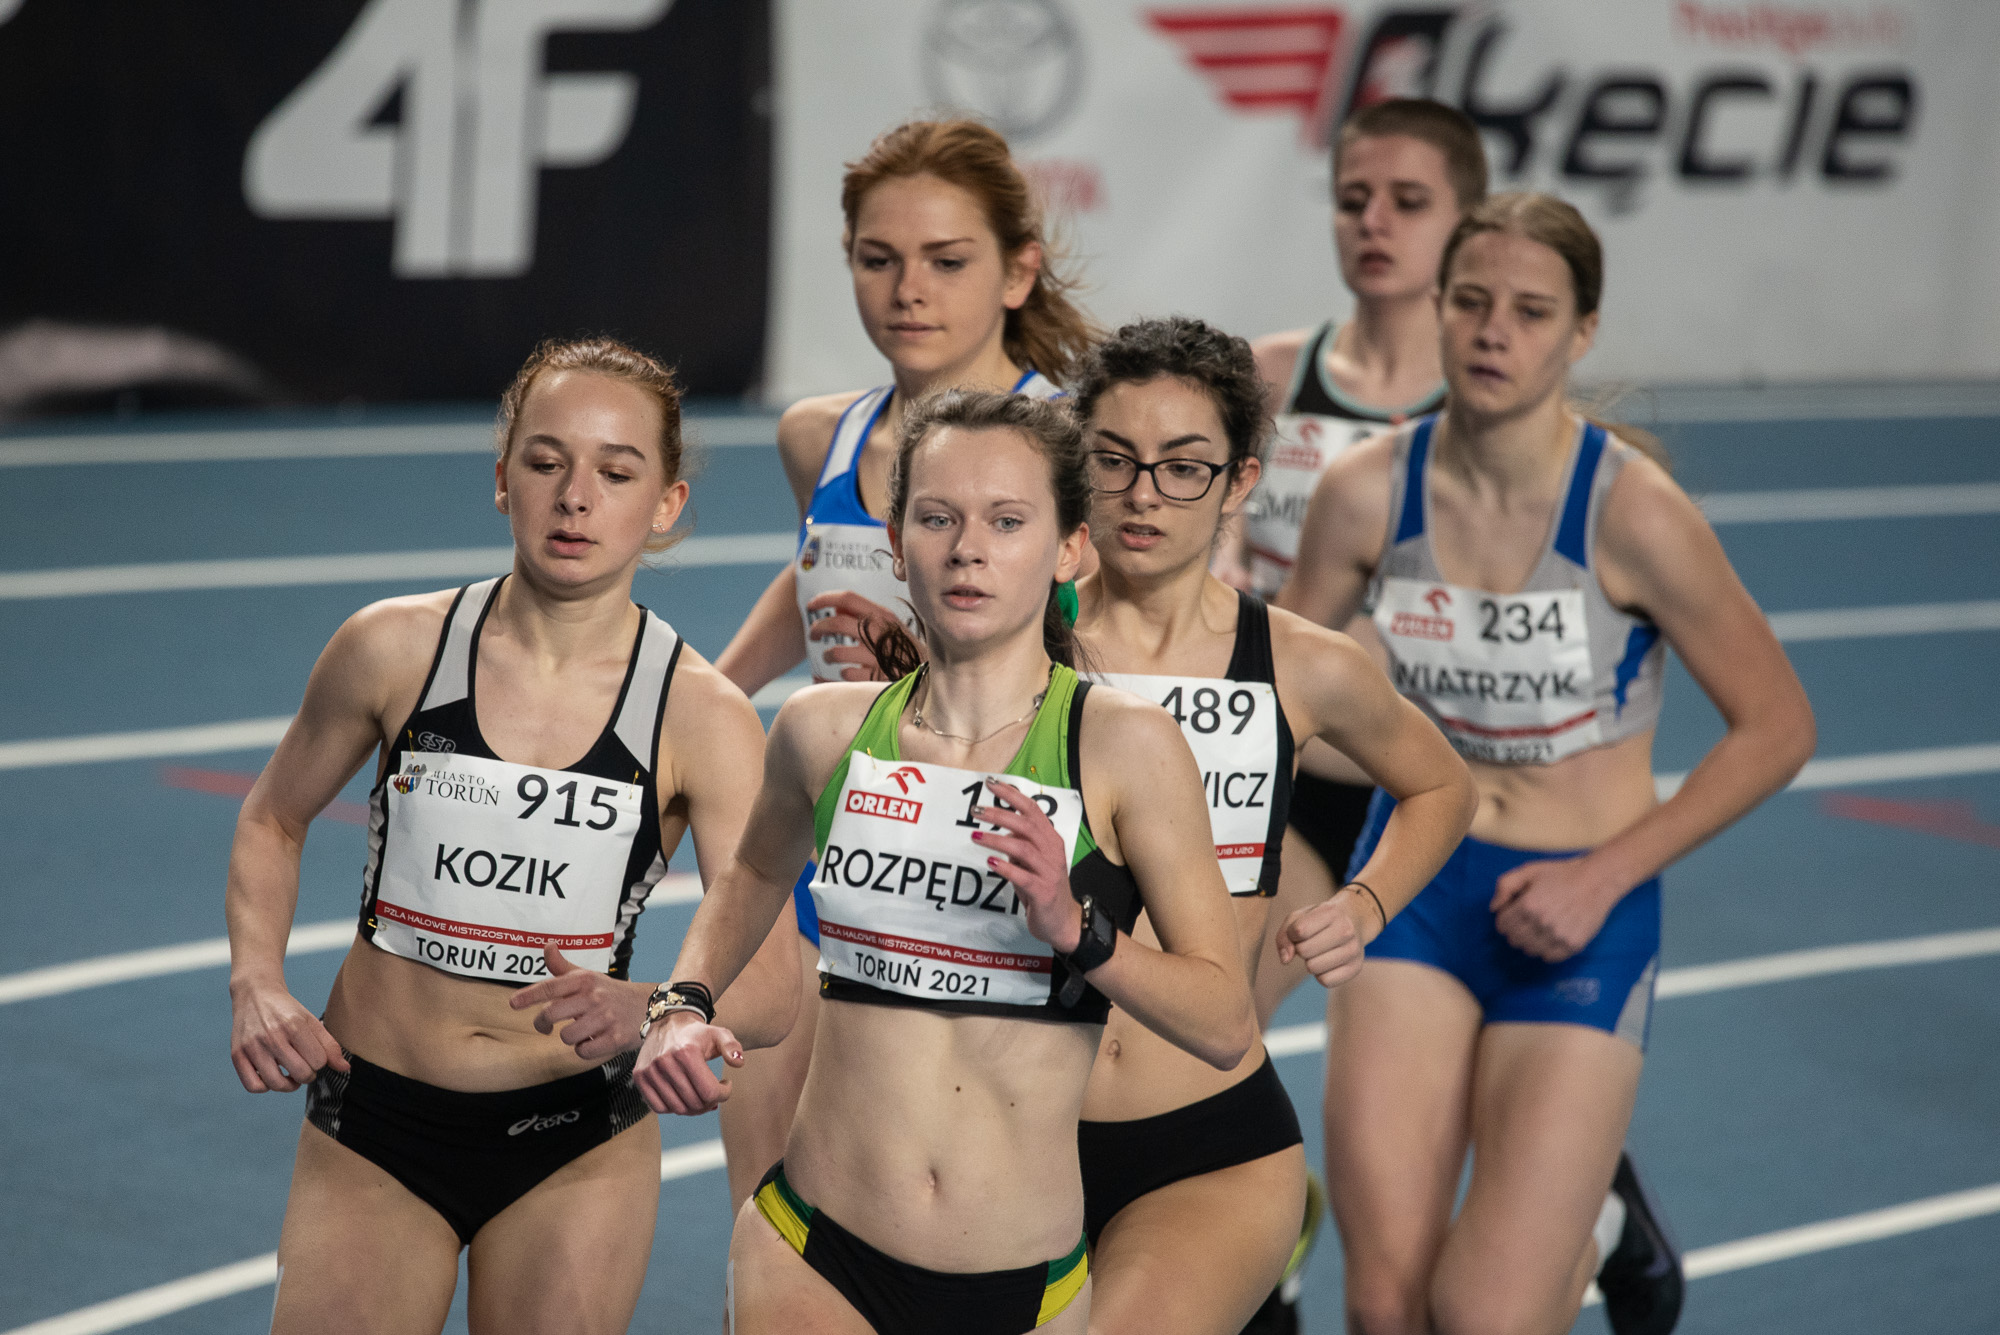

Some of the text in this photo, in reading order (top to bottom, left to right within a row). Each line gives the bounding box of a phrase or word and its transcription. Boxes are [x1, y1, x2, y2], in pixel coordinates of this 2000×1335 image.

[241, 0, 678, 279] 4F
[1479, 600, 1564, 643] 234
[1161, 686, 1256, 735] 489
[426, 778, 501, 806] TORUŃ
[517, 774, 618, 831] 915
[848, 792, 918, 822] ORLEN
[434, 843, 570, 899] KOZIK
[384, 906, 605, 946] PZLA HALOWE MISTRZOSTWA POLSKI U18 U20
[416, 937, 548, 976] TORUŃ 202
[842, 930, 877, 944] HALOWE
[878, 937, 952, 957] MISTRZOSTWA
[953, 951, 993, 964] POLSKI
[995, 956, 1015, 966] U18
[1017, 959, 1040, 968] U20
[855, 952, 990, 996] TORUŃ 2021
